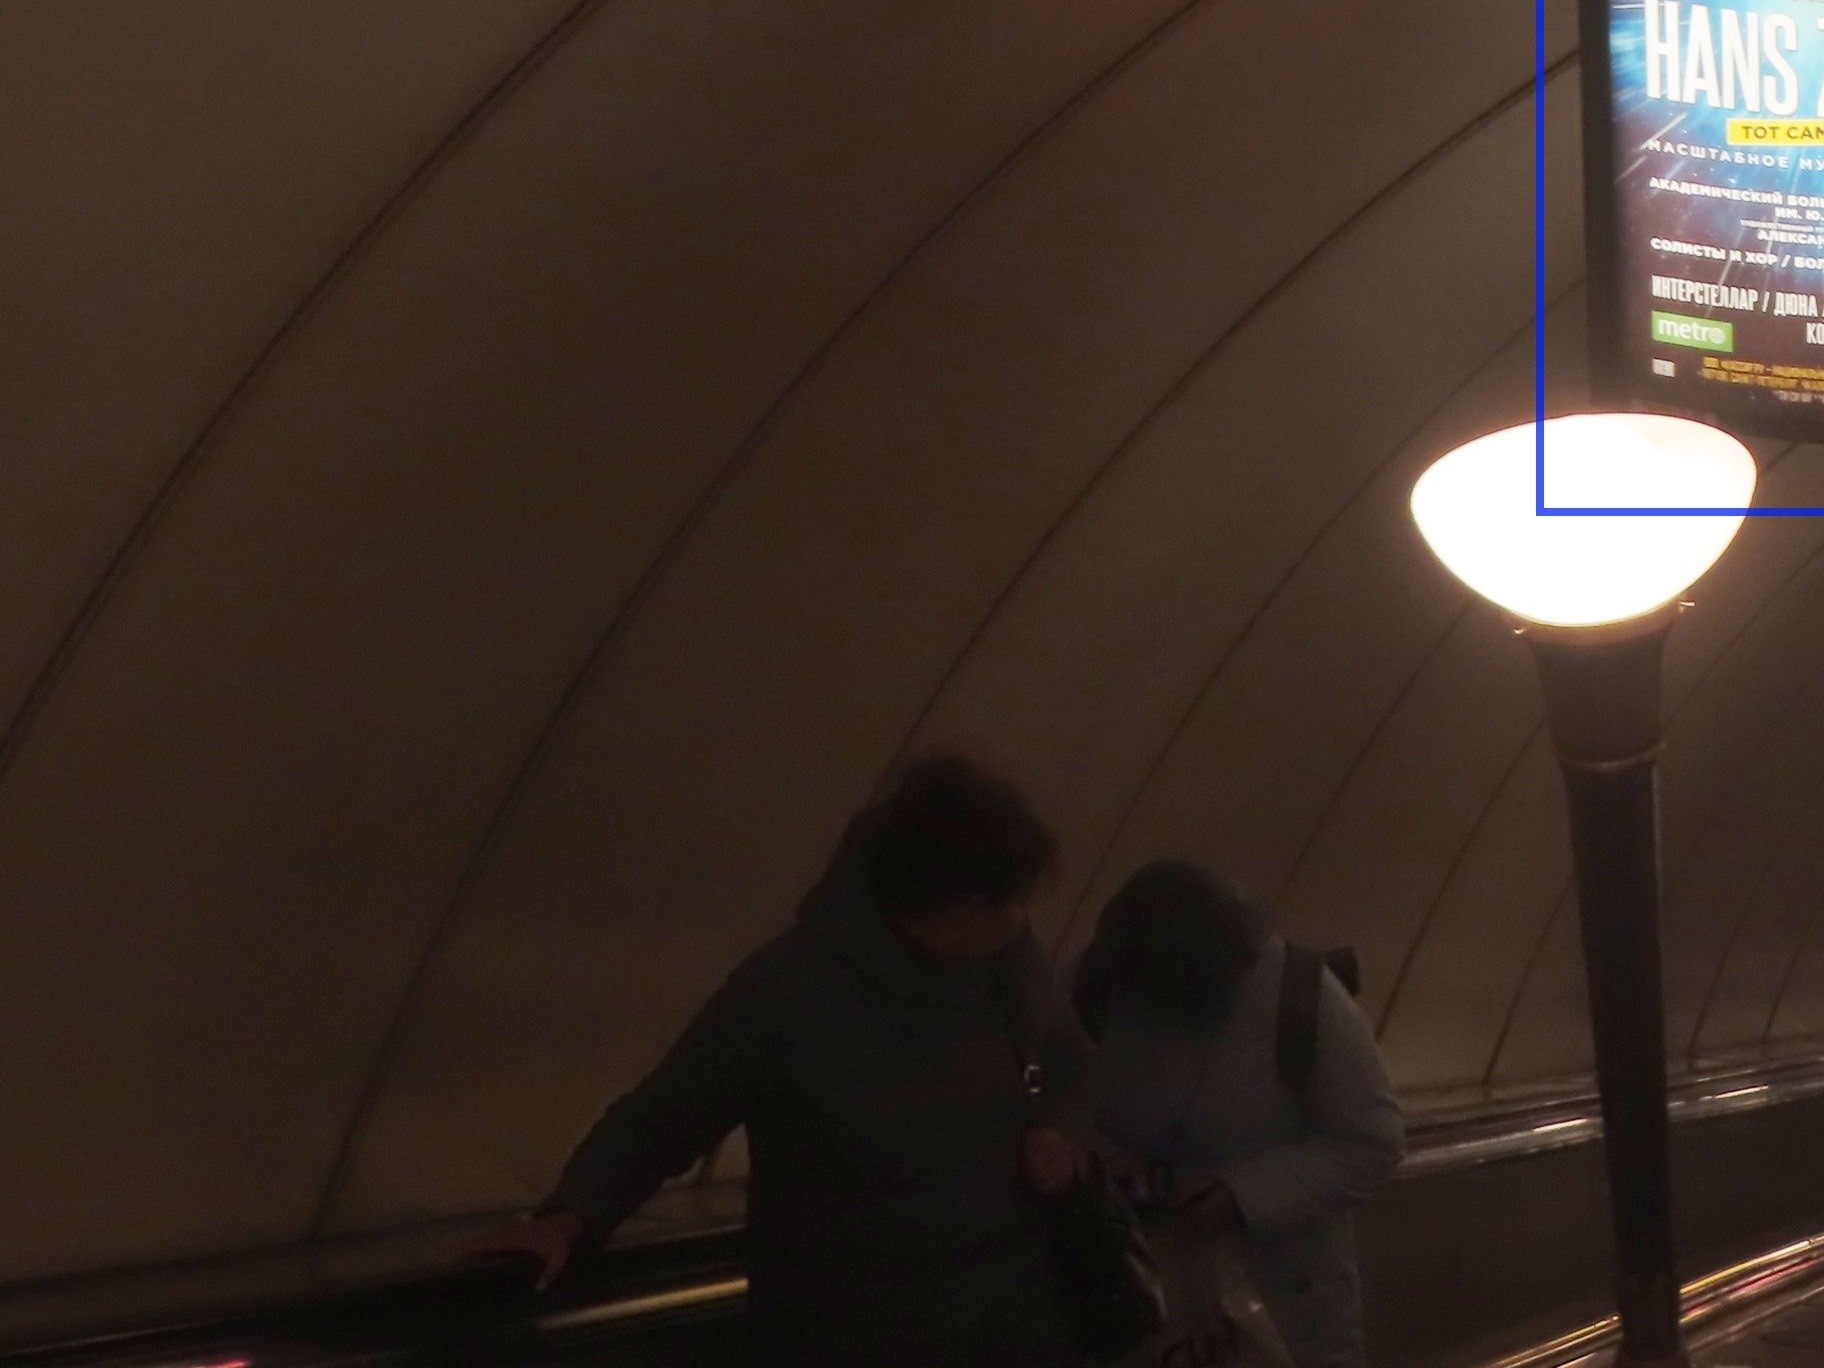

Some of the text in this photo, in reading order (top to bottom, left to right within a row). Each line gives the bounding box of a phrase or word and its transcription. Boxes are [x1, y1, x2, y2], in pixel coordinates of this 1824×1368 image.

[1742, 125, 1779, 140] ТОТ
[1647, 139, 1789, 169] МАСШТАБНОЕ
[1649, 176, 1783, 205] АКАДЕМИЧЕСКИЙ
[1775, 206, 1803, 220] ИМ.
[1650, 237, 1726, 261] СОЛИСТЫ
[1729, 249, 1741, 261] И
[1745, 250, 1778, 266] ХОР
[1651, 274, 1759, 312] ИНТЕРСТЕЛЛАР
[1773, 291, 1818, 318] ДЮНА
[1657, 318, 1727, 345] metro
